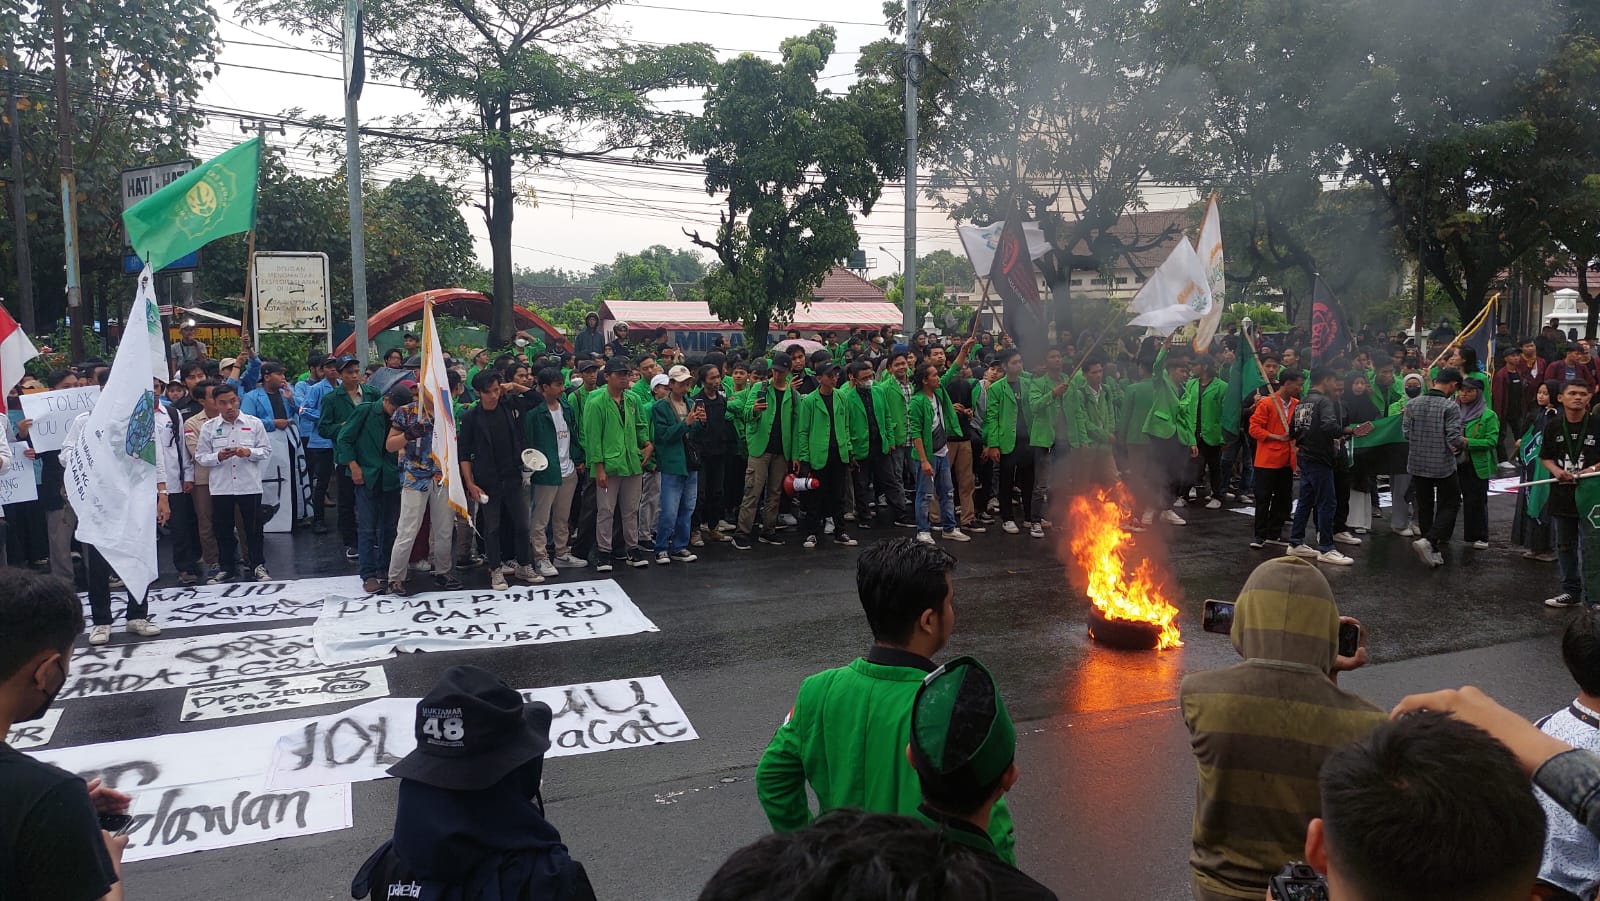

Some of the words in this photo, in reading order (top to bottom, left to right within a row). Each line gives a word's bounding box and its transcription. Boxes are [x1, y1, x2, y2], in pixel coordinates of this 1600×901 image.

[127, 175, 153, 198] HATI
[41, 391, 97, 412] TOLAK
[37, 419, 58, 437] UU
[412, 607, 500, 624] GAK
[422, 717, 465, 741] 48
